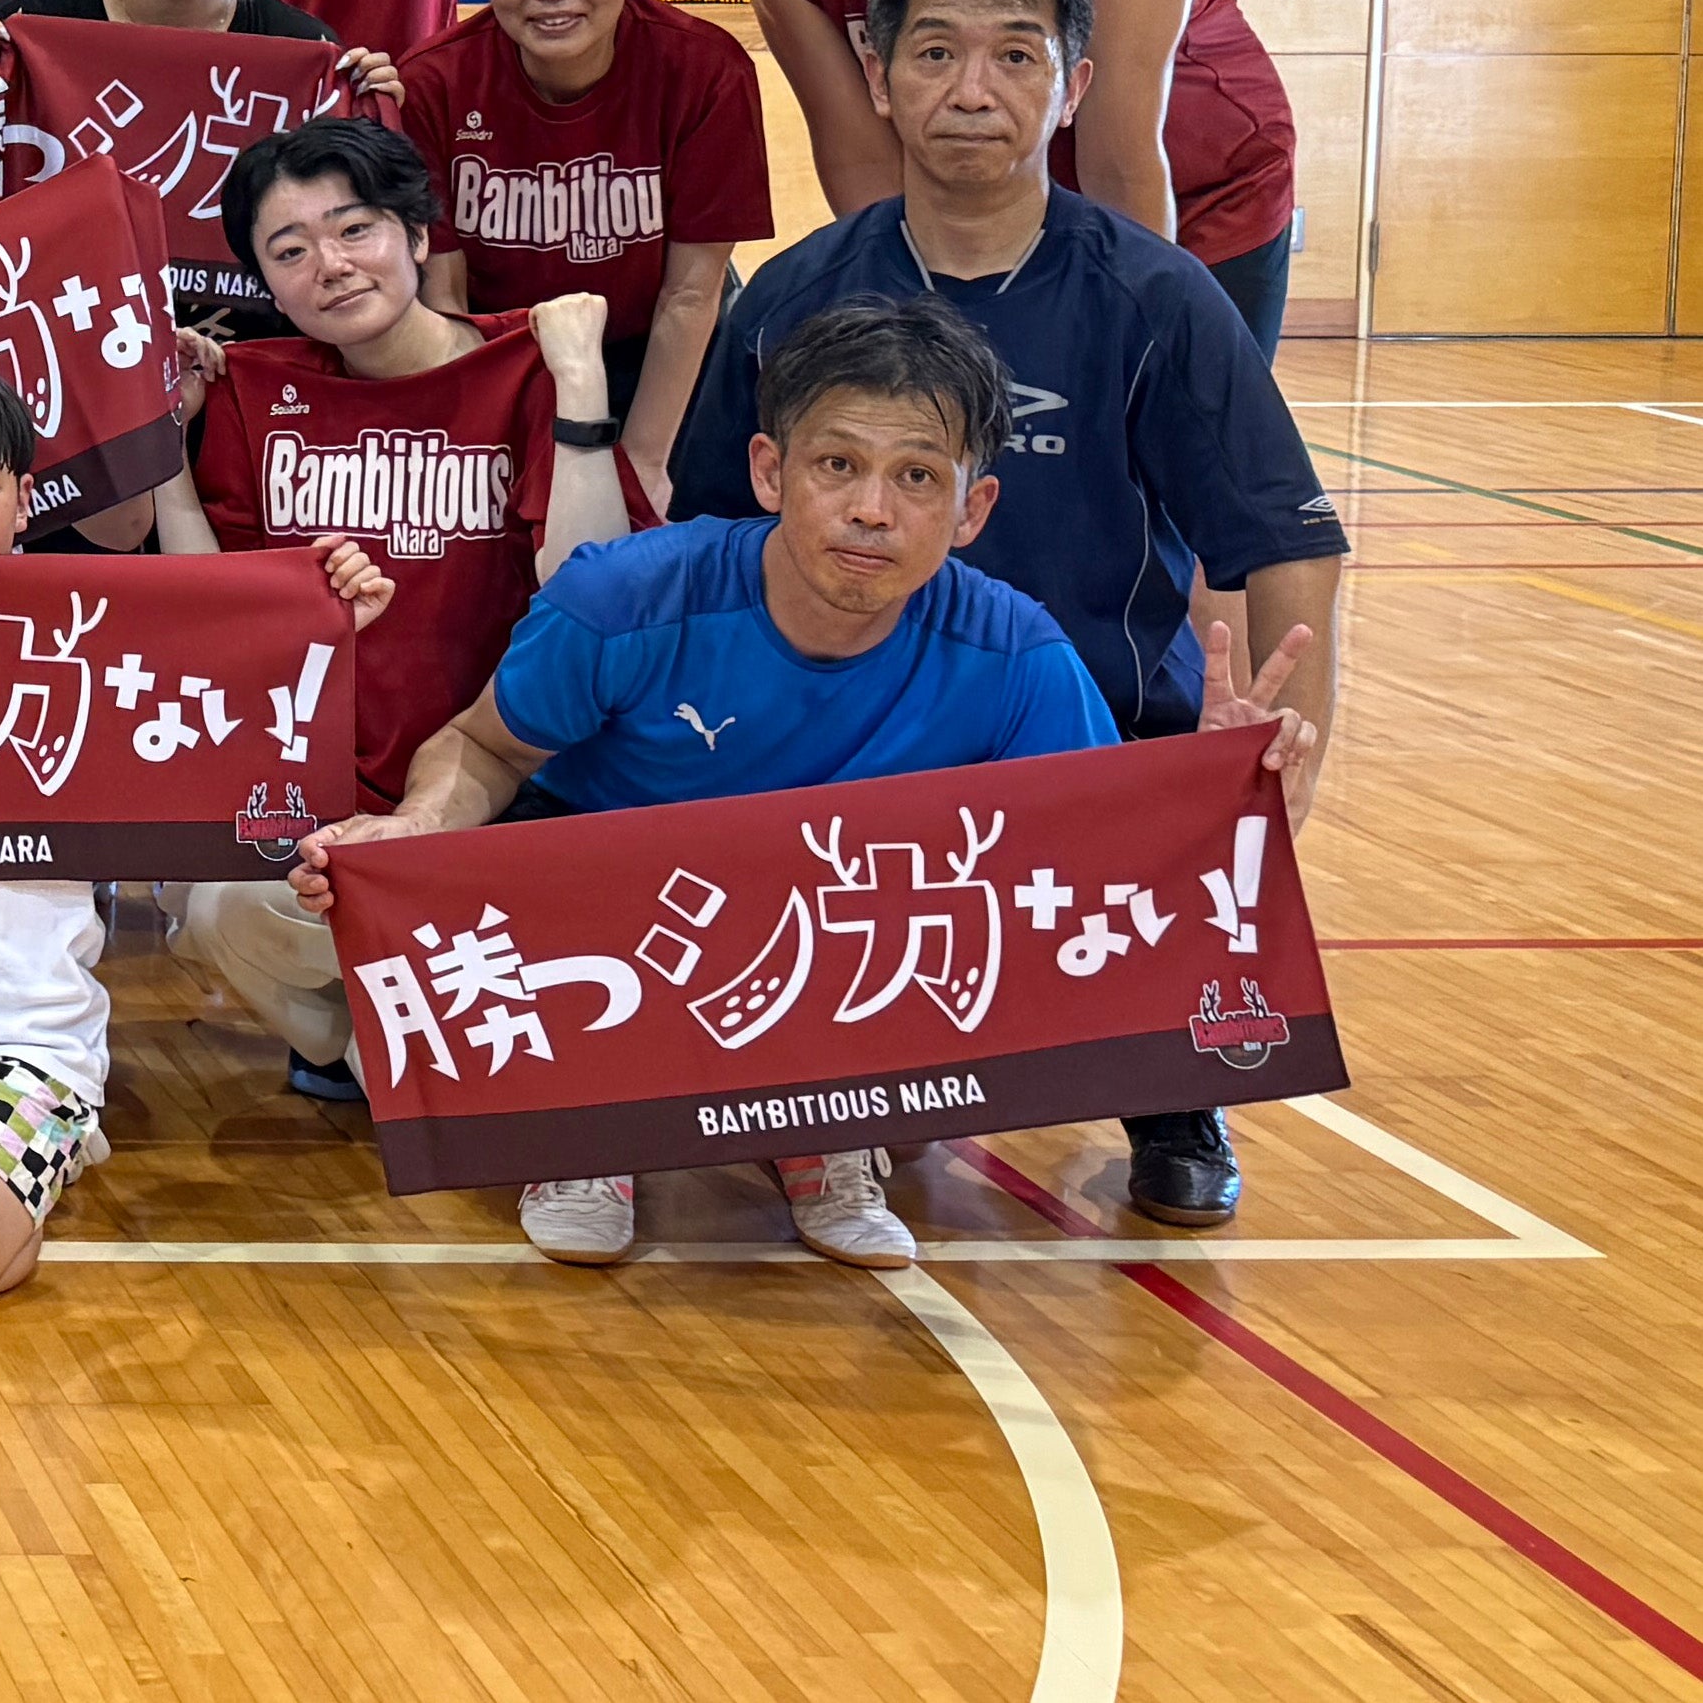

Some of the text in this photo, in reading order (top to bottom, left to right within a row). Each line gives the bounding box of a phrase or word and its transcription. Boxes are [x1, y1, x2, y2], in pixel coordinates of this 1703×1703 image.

[571, 232, 621, 260] Nara
[269, 437, 510, 530] Bambitious
[392, 523, 441, 556] Nara
[696, 1073, 986, 1138] BAMBITIOUS NARA
